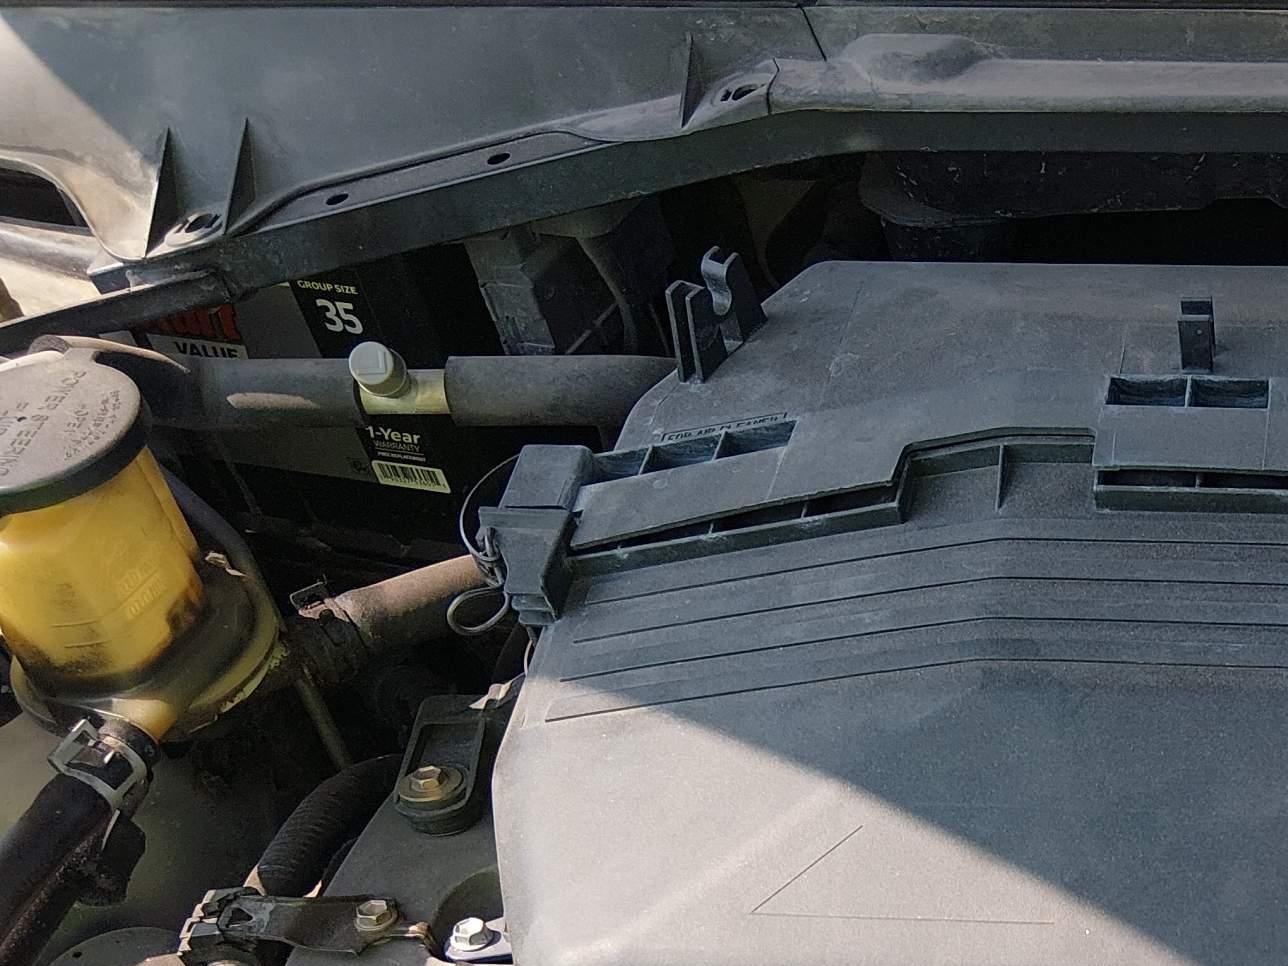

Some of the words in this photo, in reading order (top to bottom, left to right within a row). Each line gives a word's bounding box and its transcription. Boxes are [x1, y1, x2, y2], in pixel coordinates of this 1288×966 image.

[297, 280, 333, 291] GROUP
[334, 284, 359, 294] SIZE
[316, 299, 363, 334] 35
[174, 341, 239, 358] VALUE
[365, 425, 421, 444] 1-Year
